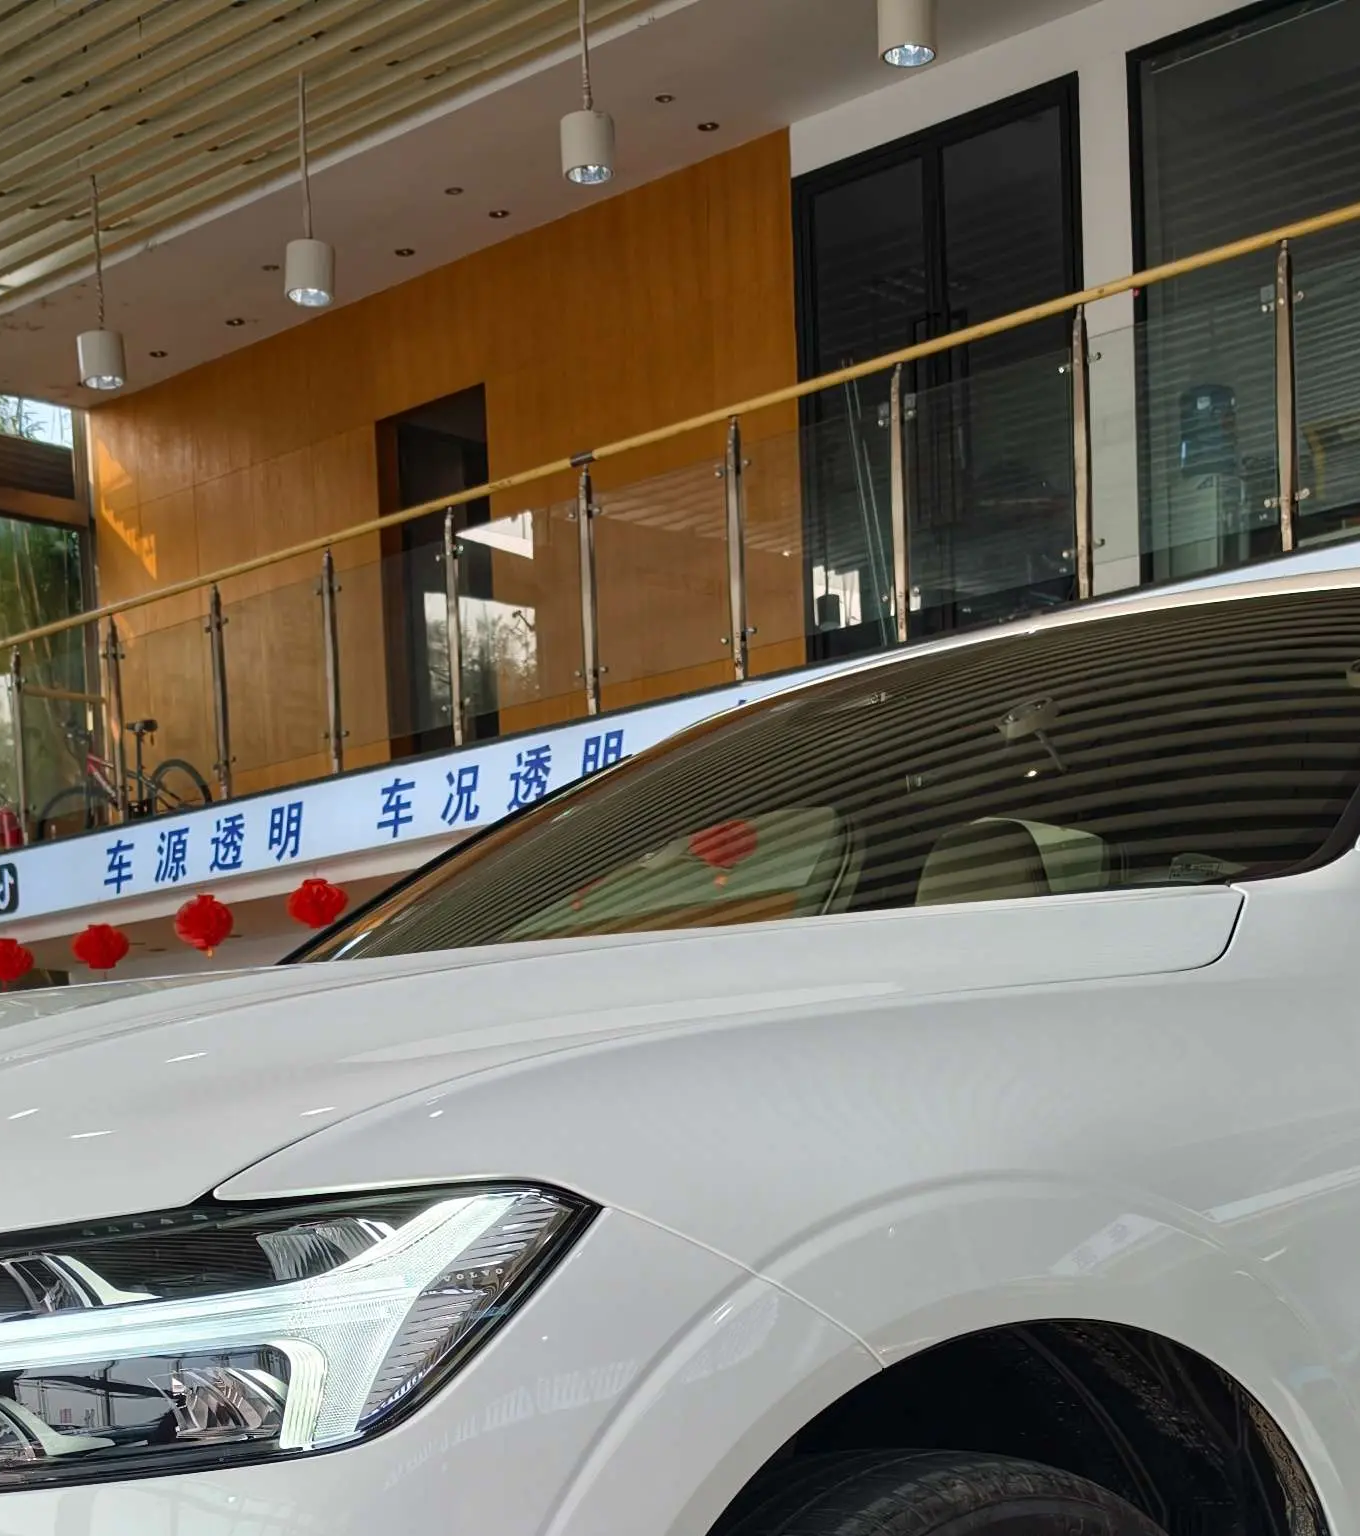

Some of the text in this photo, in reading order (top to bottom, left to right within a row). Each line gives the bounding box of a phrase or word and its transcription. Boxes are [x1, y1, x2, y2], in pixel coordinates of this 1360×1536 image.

[103, 729, 624, 895] 车源透明 车况透明
[443, 1268, 503, 1282] VOLVO
